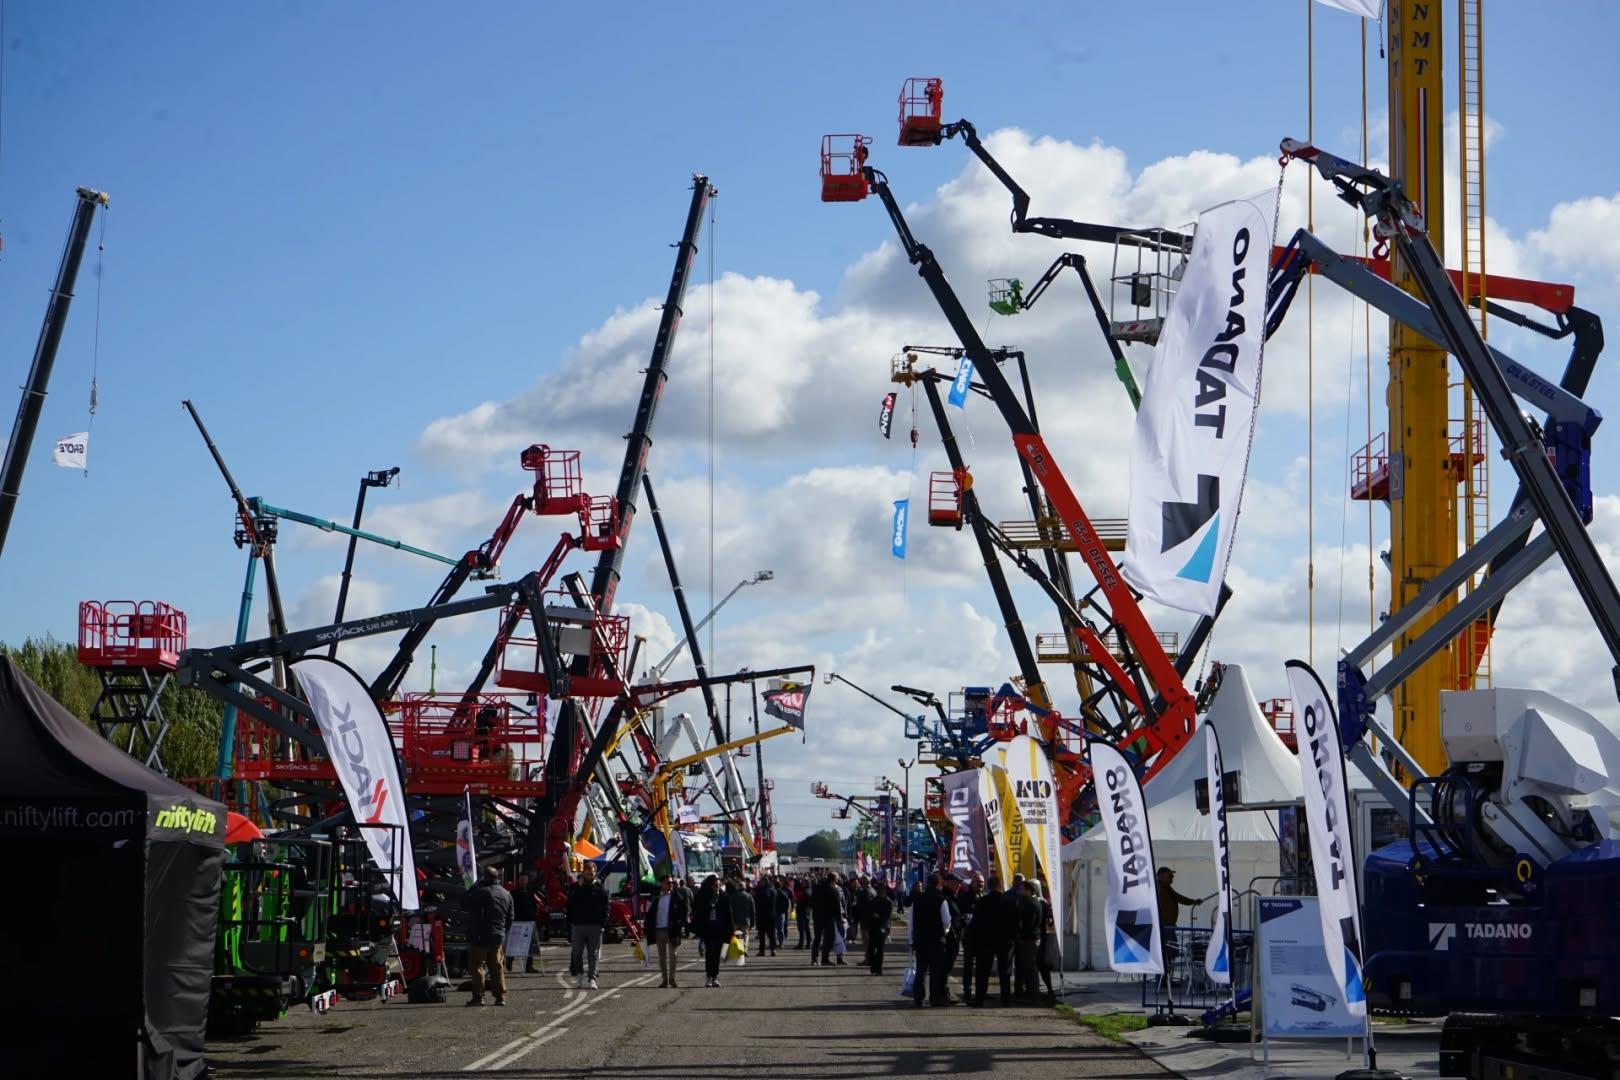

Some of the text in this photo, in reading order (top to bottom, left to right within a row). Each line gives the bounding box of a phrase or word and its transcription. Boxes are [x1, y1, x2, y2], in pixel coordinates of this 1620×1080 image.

[1411, 4, 1431, 76] NMT
[1088, 547, 1118, 589] DIESEL
[316, 626, 365, 641] SKYJACK
[155, 805, 217, 834] niftylift
[1106, 768, 1139, 895] TADANO
[1465, 922, 1532, 939] TADANO
